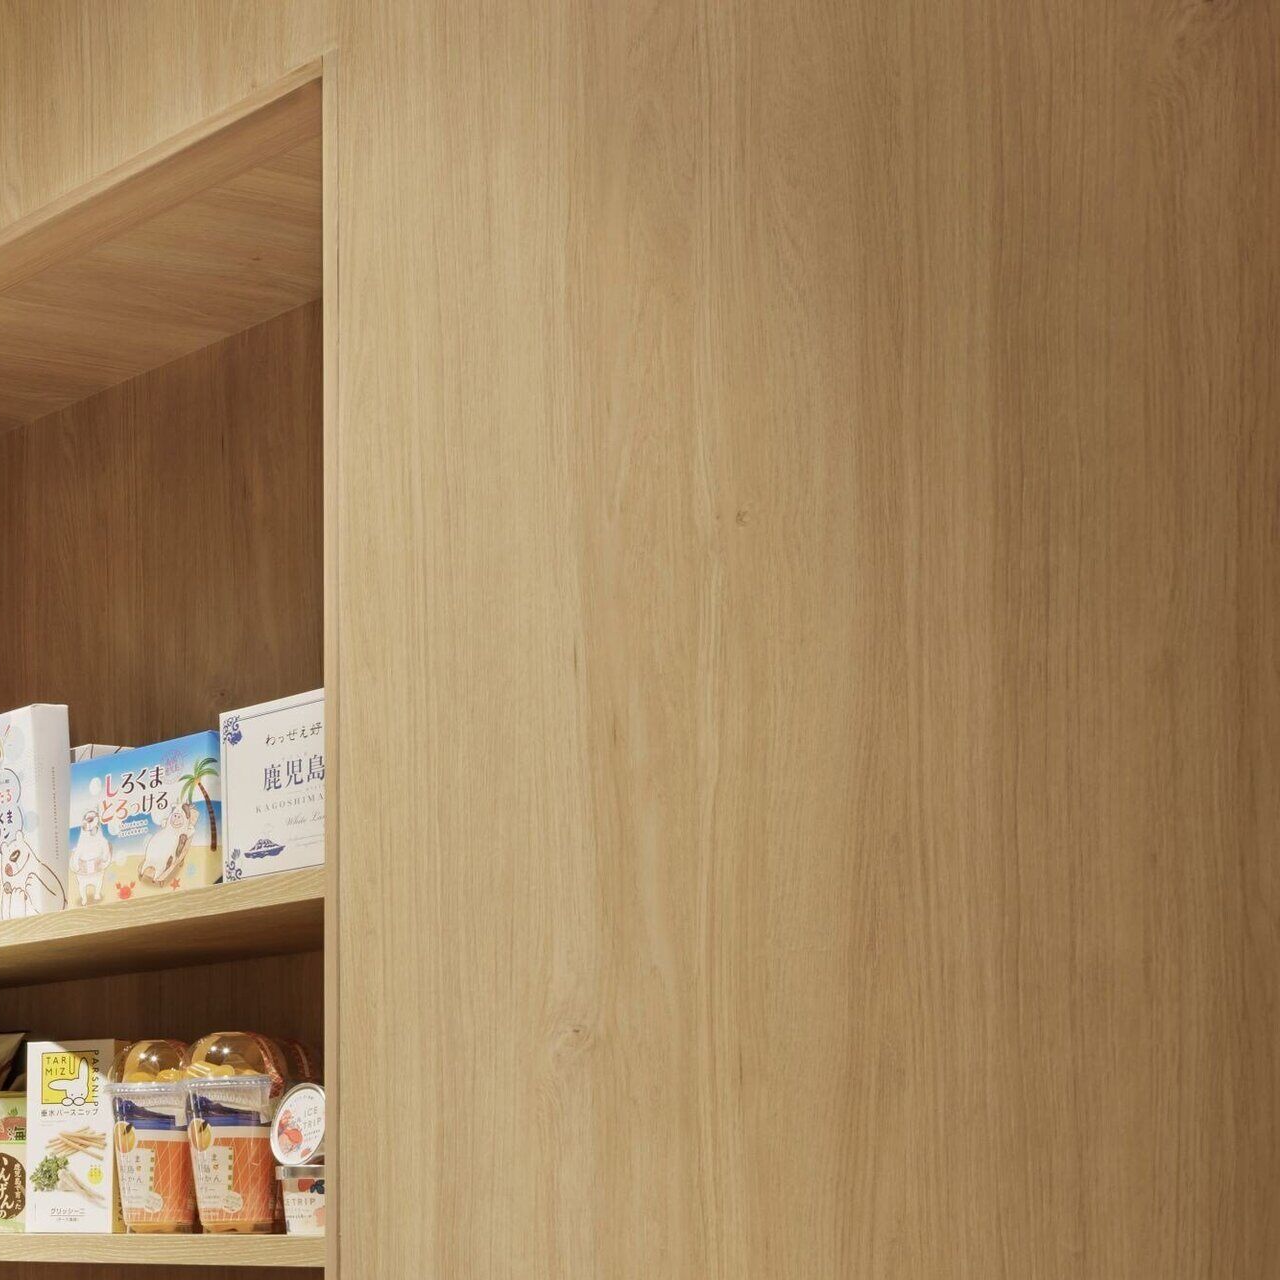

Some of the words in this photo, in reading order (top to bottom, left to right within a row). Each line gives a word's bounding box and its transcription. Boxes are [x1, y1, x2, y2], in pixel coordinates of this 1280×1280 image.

[106, 764, 165, 798] しろくま
[263, 754, 325, 792] 鹿児島
[255, 792, 324, 814] KAGOSHIMA
[91, 1049, 100, 1107] PARSNIP
[302, 1117, 322, 1131] TRIP
[304, 1106, 319, 1118] ICE
